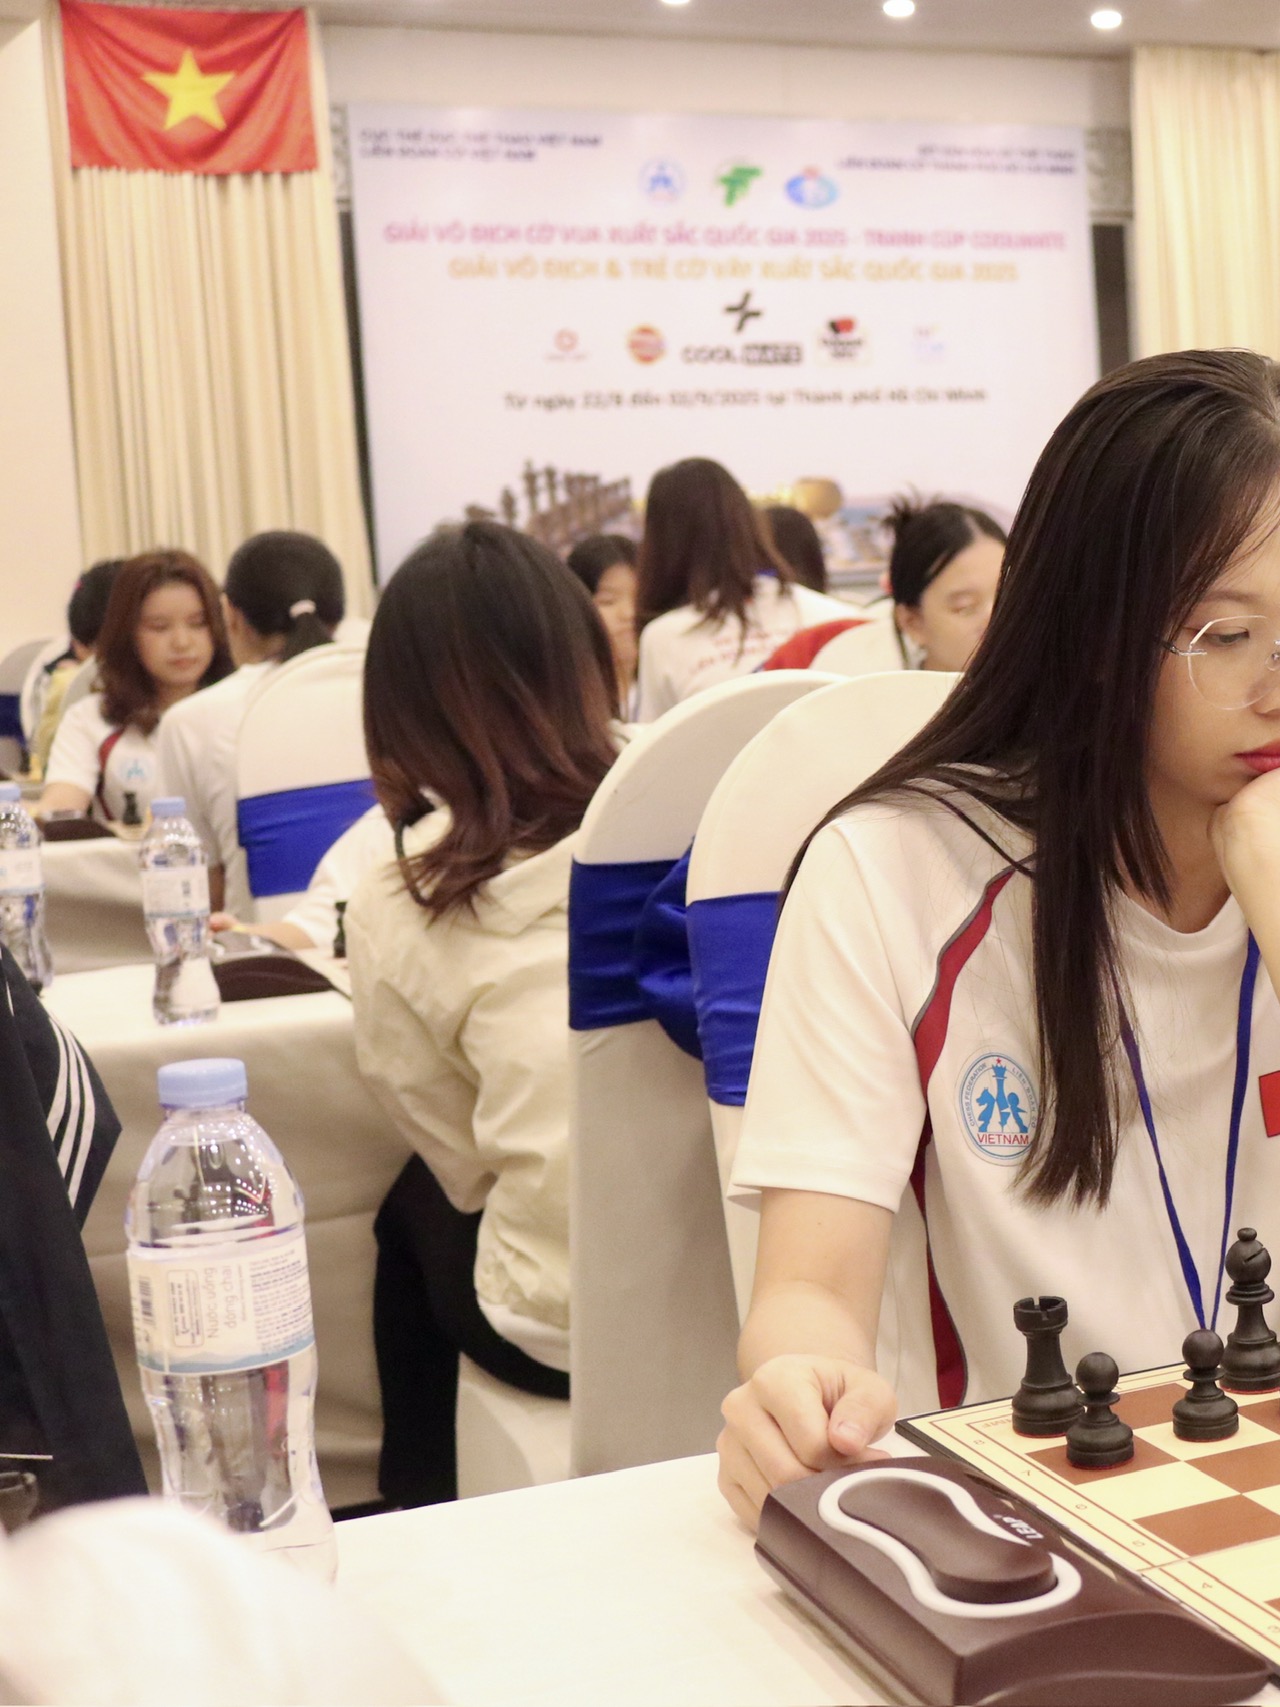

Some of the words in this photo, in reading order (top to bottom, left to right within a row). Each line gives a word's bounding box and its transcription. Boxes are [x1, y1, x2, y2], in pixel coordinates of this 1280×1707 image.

[965, 1062, 988, 1100] FEDERATION
[976, 1133, 1030, 1145] VIETNAM
[1002, 1516, 1044, 1539] LEAP
